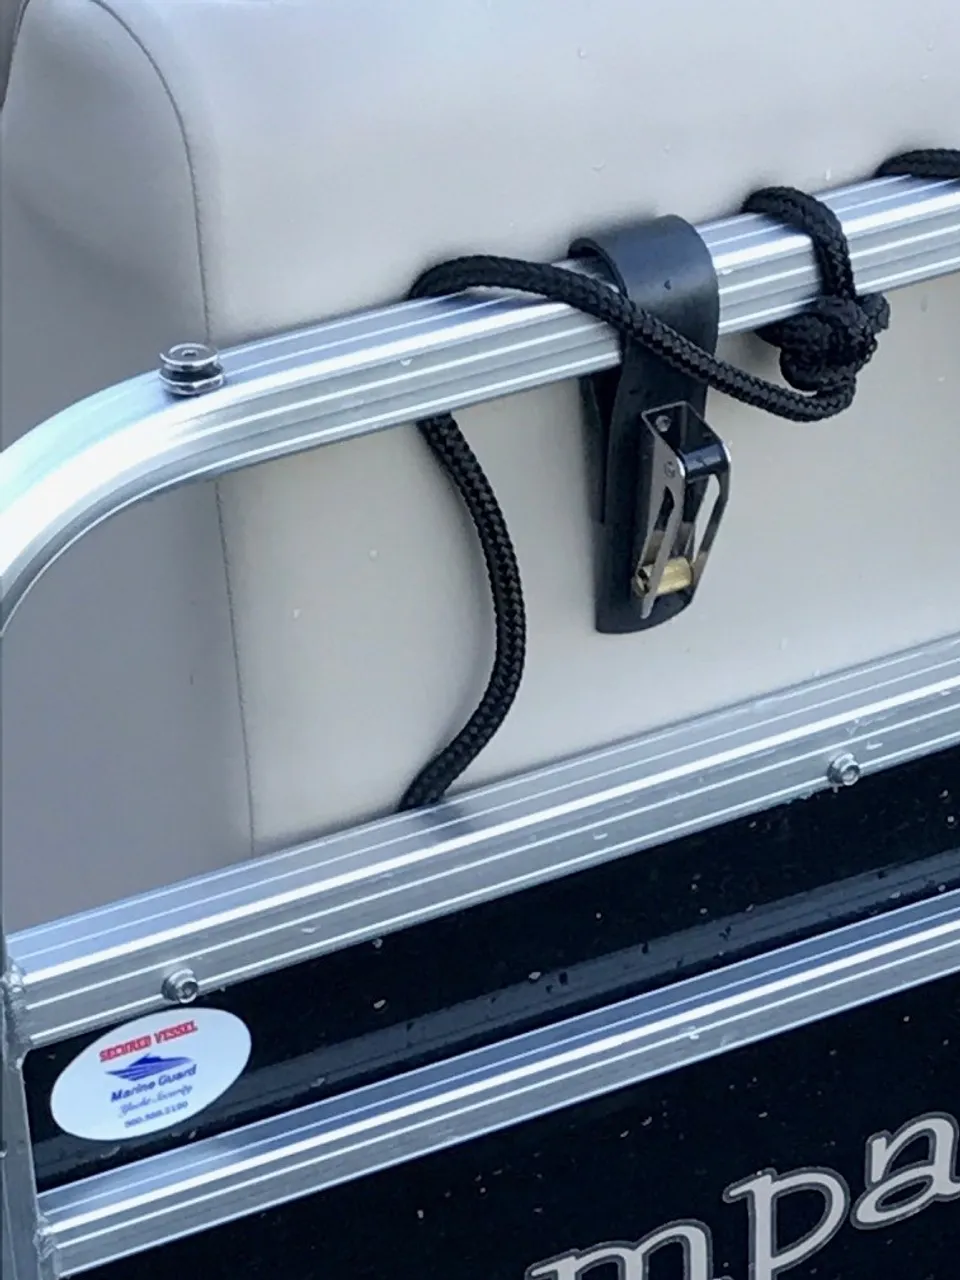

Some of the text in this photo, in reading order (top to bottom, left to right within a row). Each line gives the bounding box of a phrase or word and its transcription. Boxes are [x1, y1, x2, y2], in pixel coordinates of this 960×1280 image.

[153, 1020, 198, 1044] VESSEL
[110, 1064, 198, 1103] Marine Guard
